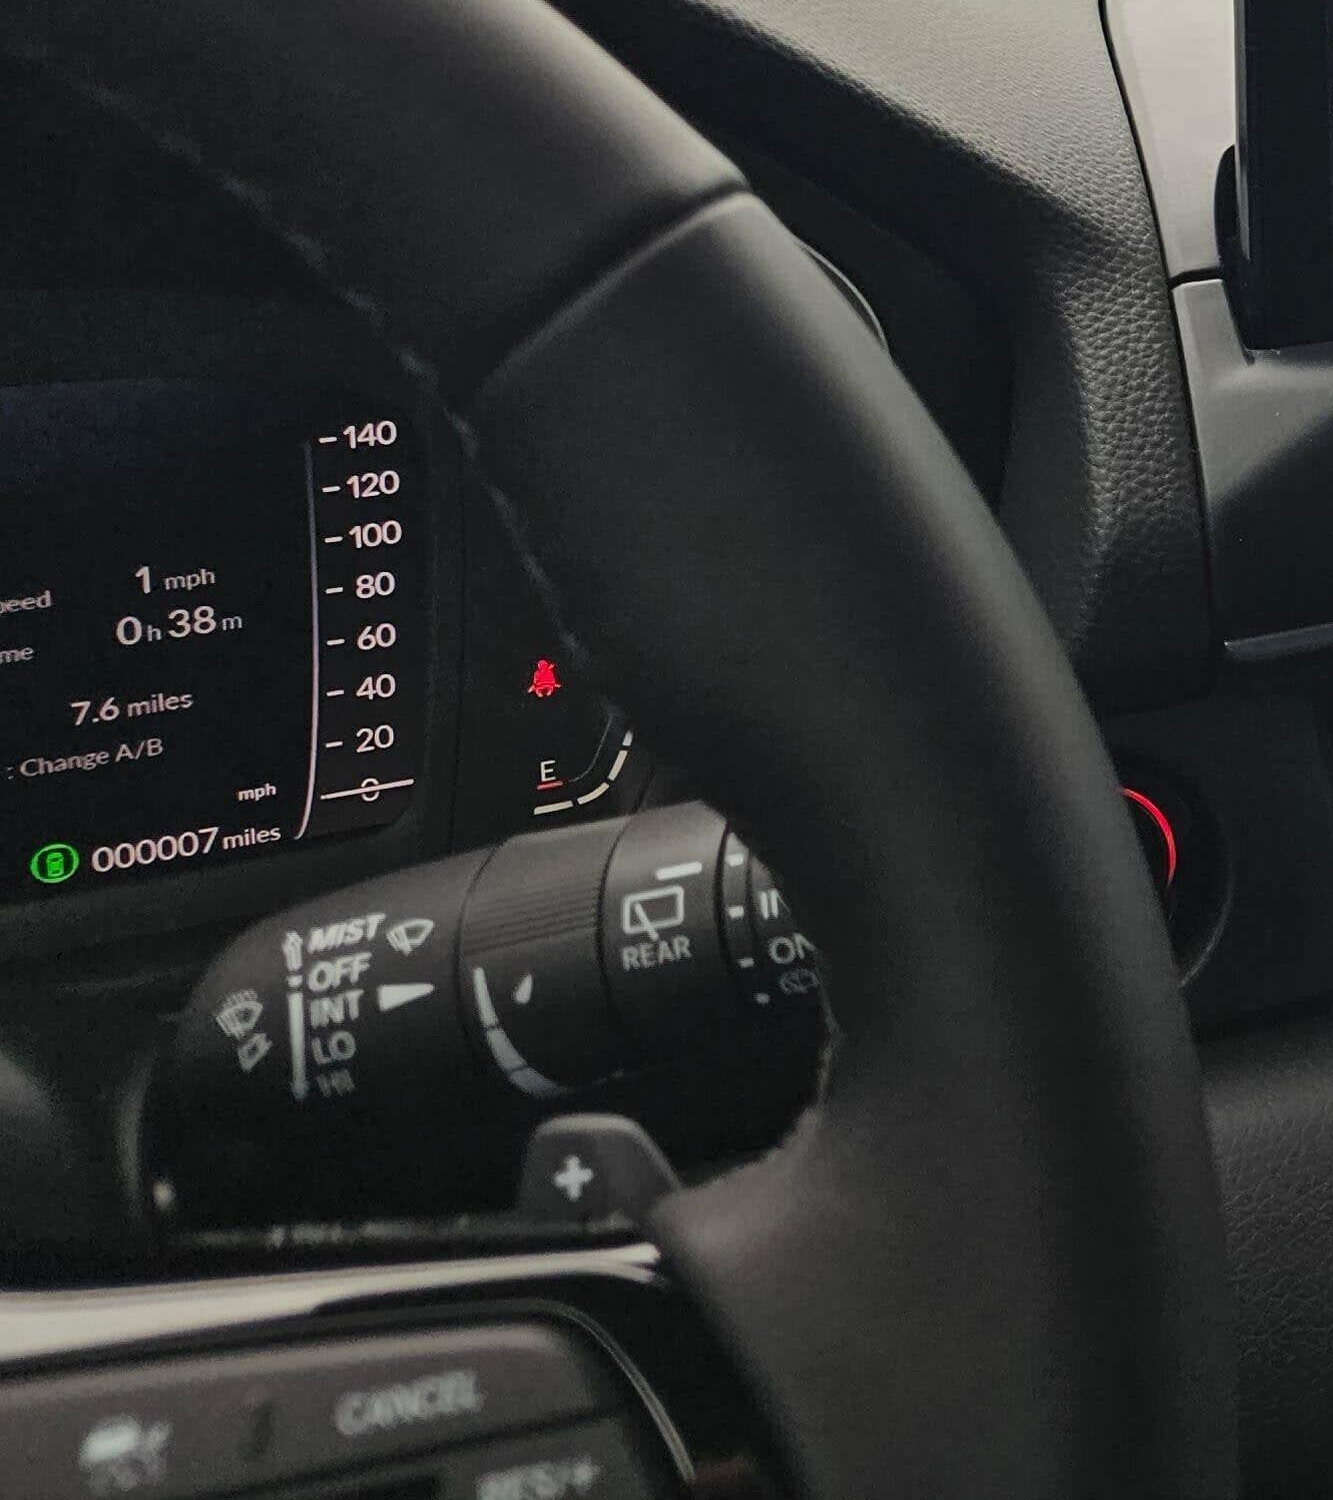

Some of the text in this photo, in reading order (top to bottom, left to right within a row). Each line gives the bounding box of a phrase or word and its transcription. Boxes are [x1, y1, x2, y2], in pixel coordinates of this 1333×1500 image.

[342, 420, 397, 450] 140
[346, 470, 400, 499] 120
[348, 520, 403, 549] 100
[135, 566, 216, 594] 1 mph
[355, 571, 396, 600] 80
[356, 622, 397, 651] 60
[355, 673, 396, 700] 40
[70, 692, 194, 726] 7.6 miles
[356, 724, 395, 753] 20
[19, 750, 110, 777] Change
[115, 737, 164, 762] A/B
[540, 759, 556, 783] E
[237, 782, 277, 801] mph
[91, 826, 282, 873] 000007 miles
[307, 912, 386, 956] MIST
[621, 932, 691, 970] REAR
[307, 949, 372, 995] OFF
[308, 986, 364, 1027] INT
[311, 1030, 356, 1064] LO
